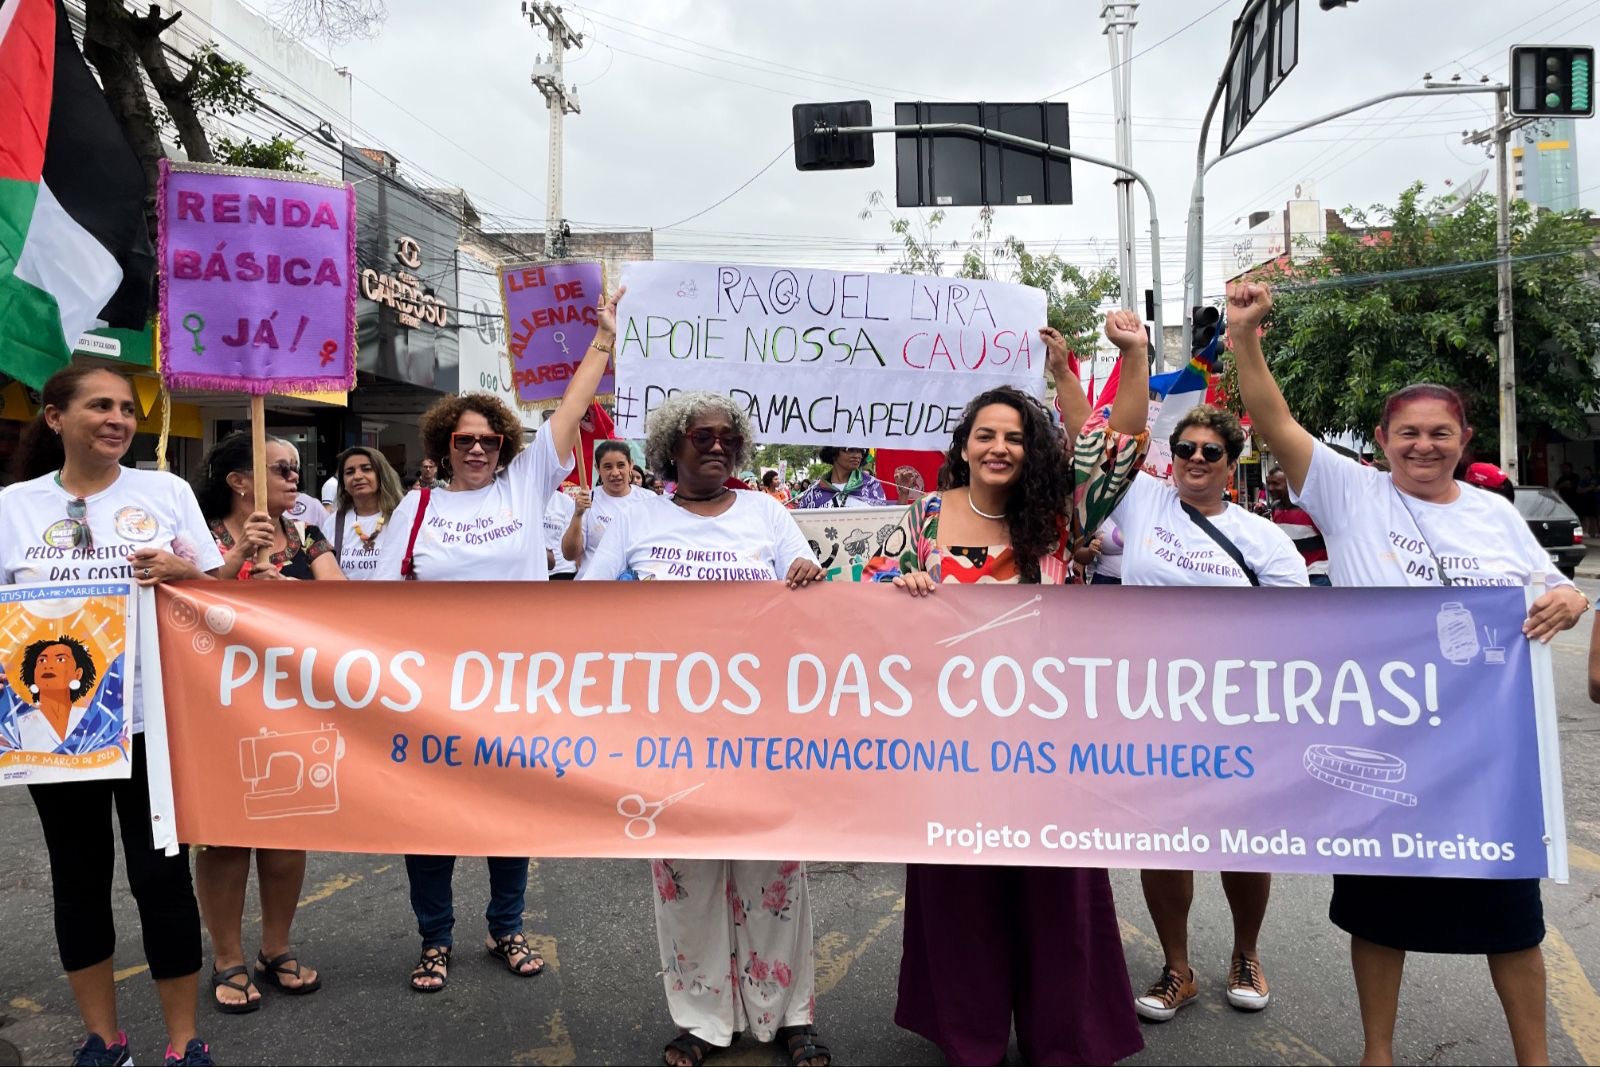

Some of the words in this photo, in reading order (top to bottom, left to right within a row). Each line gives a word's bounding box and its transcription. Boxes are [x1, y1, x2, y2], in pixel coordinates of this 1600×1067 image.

[177, 191, 340, 230] RENDA
[173, 239, 342, 287] BÁSICA
[361, 268, 448, 327] CARDOSO
[507, 266, 546, 293] LEI
[554, 279, 585, 303] DE
[718, 266, 889, 321] RAQUEL
[910, 278, 997, 328] LYRA
[511, 304, 599, 359] ALIENAÇ
[744, 326, 886, 367] NOSSA
[903, 330, 1031, 370] CAUSA
[25, 546, 64, 560] PELOS
[442, 532, 461, 543] DAS
[650, 546, 682, 560] PELOS
[686, 549, 738, 562] DIREITOS
[1388, 530, 1425, 555] PELOS
[50, 566, 81, 581] DAS
[668, 563, 692, 578] DAS
[697, 566, 773, 581] COSTUREIRAS
[1155, 547, 1176, 562] DAS
[1176, 555, 1243, 579] COSTUREIRAS
[1406, 560, 1435, 581] DAS
[1, 590, 45, 601] JUSTIÇA
[62, 586, 114, 596] MARIELLE
[218, 645, 426, 713] PELOS
[449, 651, 761, 718] DIREITOS
[786, 653, 914, 718] DAS
[937, 655, 1442, 727] COSTUREIRAS!
[42, 756, 79, 768] MARÇO
[390, 734, 409, 763] 8
[421, 735, 462, 766] DE
[474, 735, 597, 778] MARÇO
[635, 736, 694, 769] DIA
[705, 737, 979, 773] INTERNACIONAL
[991, 740, 1057, 774] DAS
[1068, 743, 1255, 778] MULHERES
[926, 822, 1031, 854] Projeto
[1040, 824, 1210, 853] Costurando
[1220, 828, 1307, 856] Moda
[1316, 836, 1389, 858] com
[1392, 832, 1516, 862] Direitos
